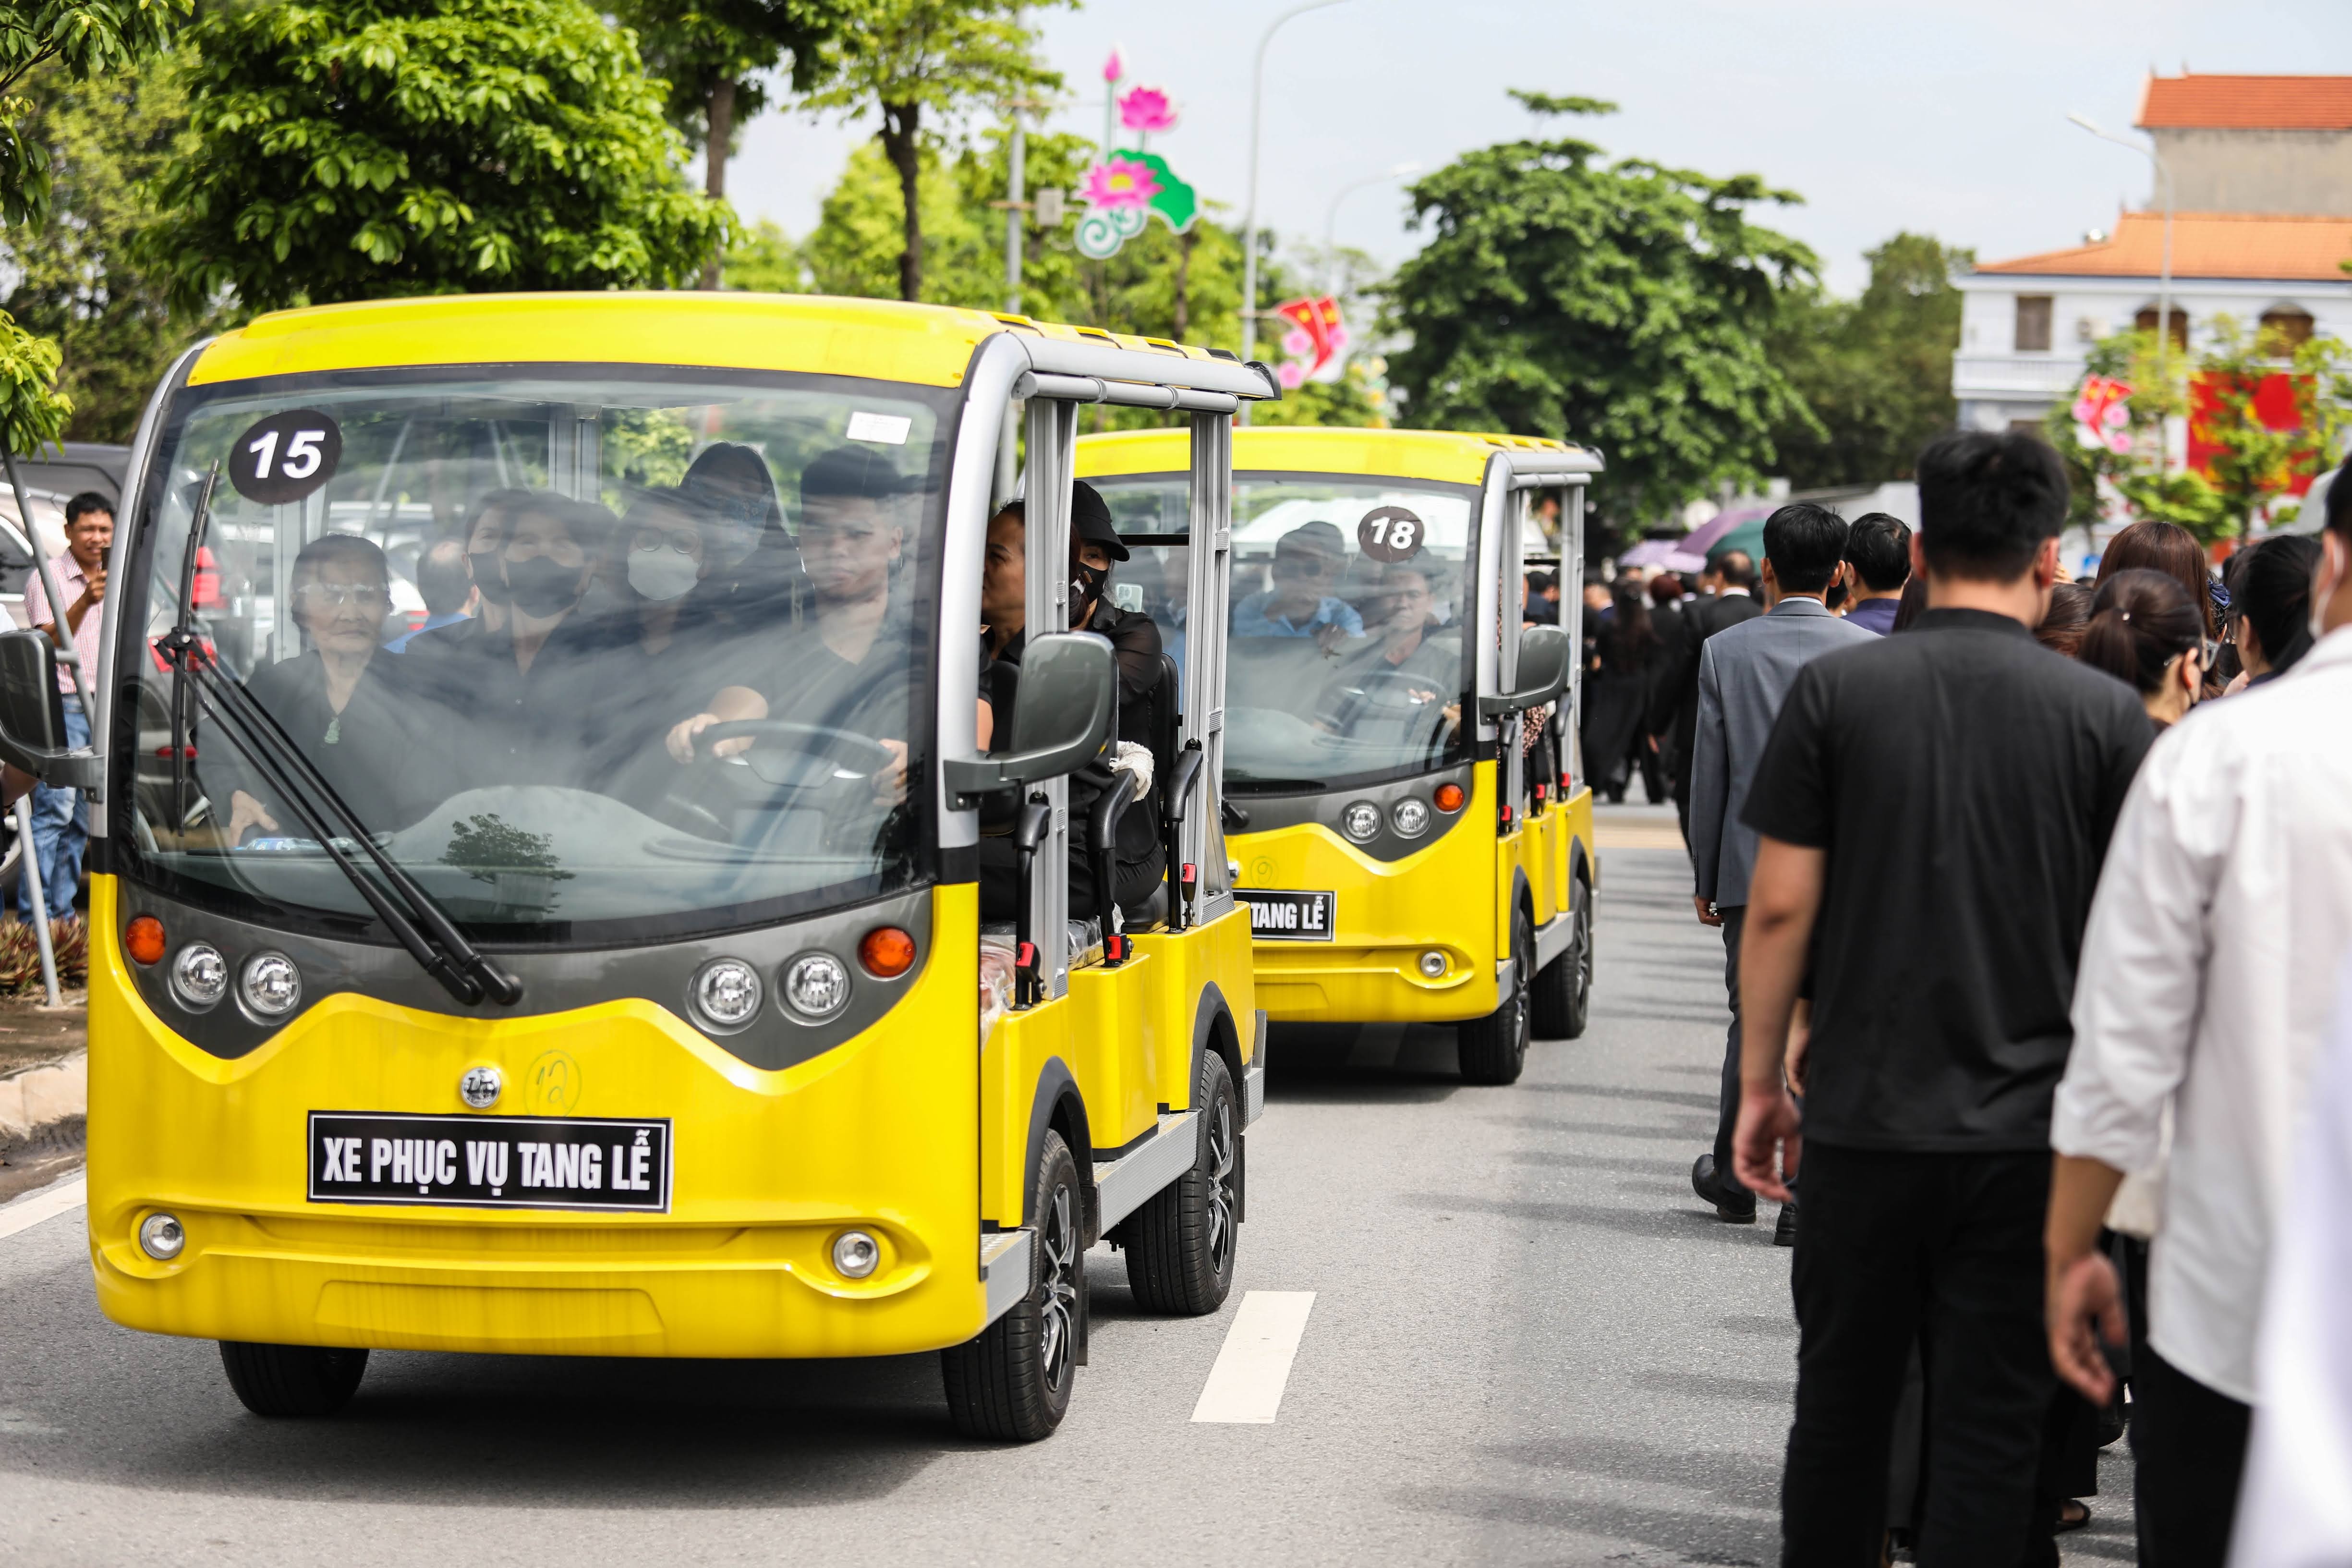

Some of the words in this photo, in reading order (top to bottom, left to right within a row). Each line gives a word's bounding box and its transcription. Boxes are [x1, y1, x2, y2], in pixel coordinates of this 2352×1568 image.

[249, 430, 326, 479] 15
[1371, 516, 1415, 549] 18
[1250, 902, 1297, 929] TANG
[1302, 895, 1324, 930] LỄ
[323, 1137, 362, 1182] XE
[371, 1138, 457, 1194] PHỤC
[466, 1141, 509, 1196] VỤ
[517, 1142, 602, 1190] TANG
[612, 1129, 651, 1191] LỄ
